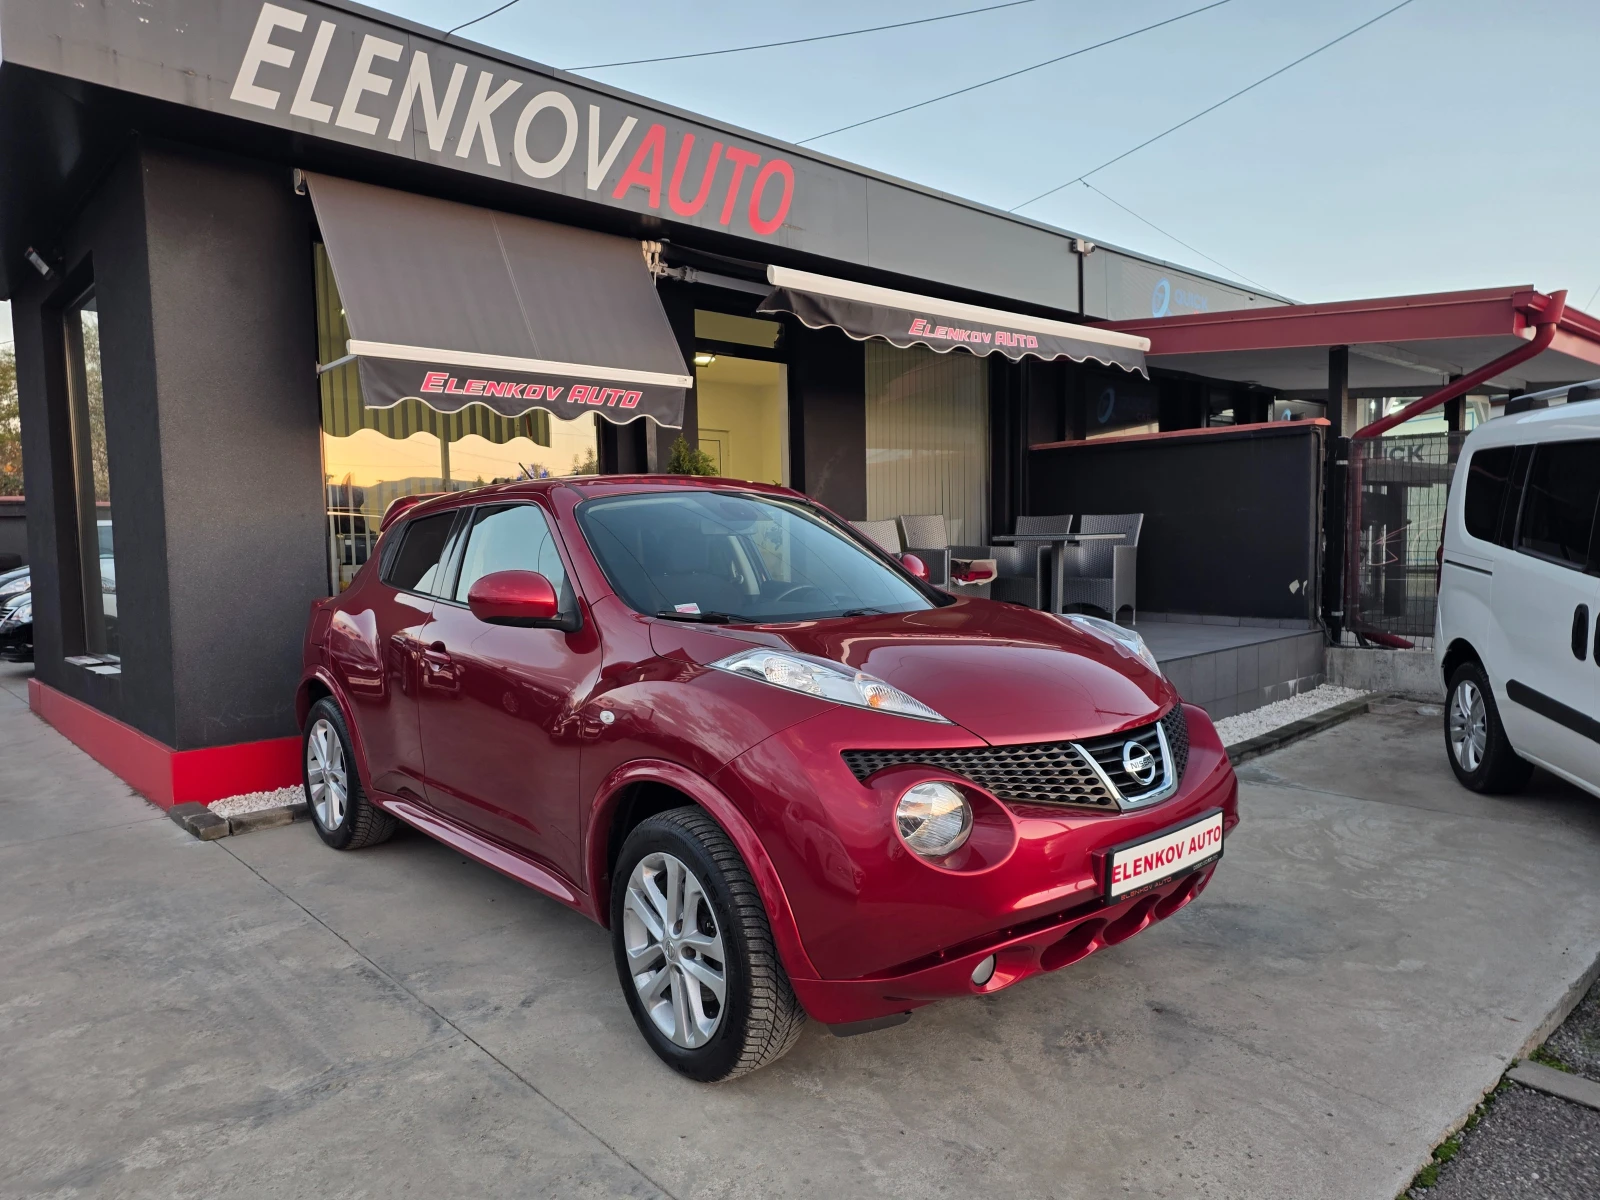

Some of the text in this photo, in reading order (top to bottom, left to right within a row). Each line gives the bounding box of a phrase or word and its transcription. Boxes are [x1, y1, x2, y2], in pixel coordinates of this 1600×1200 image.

[1174, 288, 1209, 312] QUICK
[908, 318, 1039, 349] ELENKOV AUTO
[420, 371, 643, 409] ELENKOV AUTO
[1111, 841, 1185, 885] ELENKOV
[1188, 825, 1221, 855] AUTO
